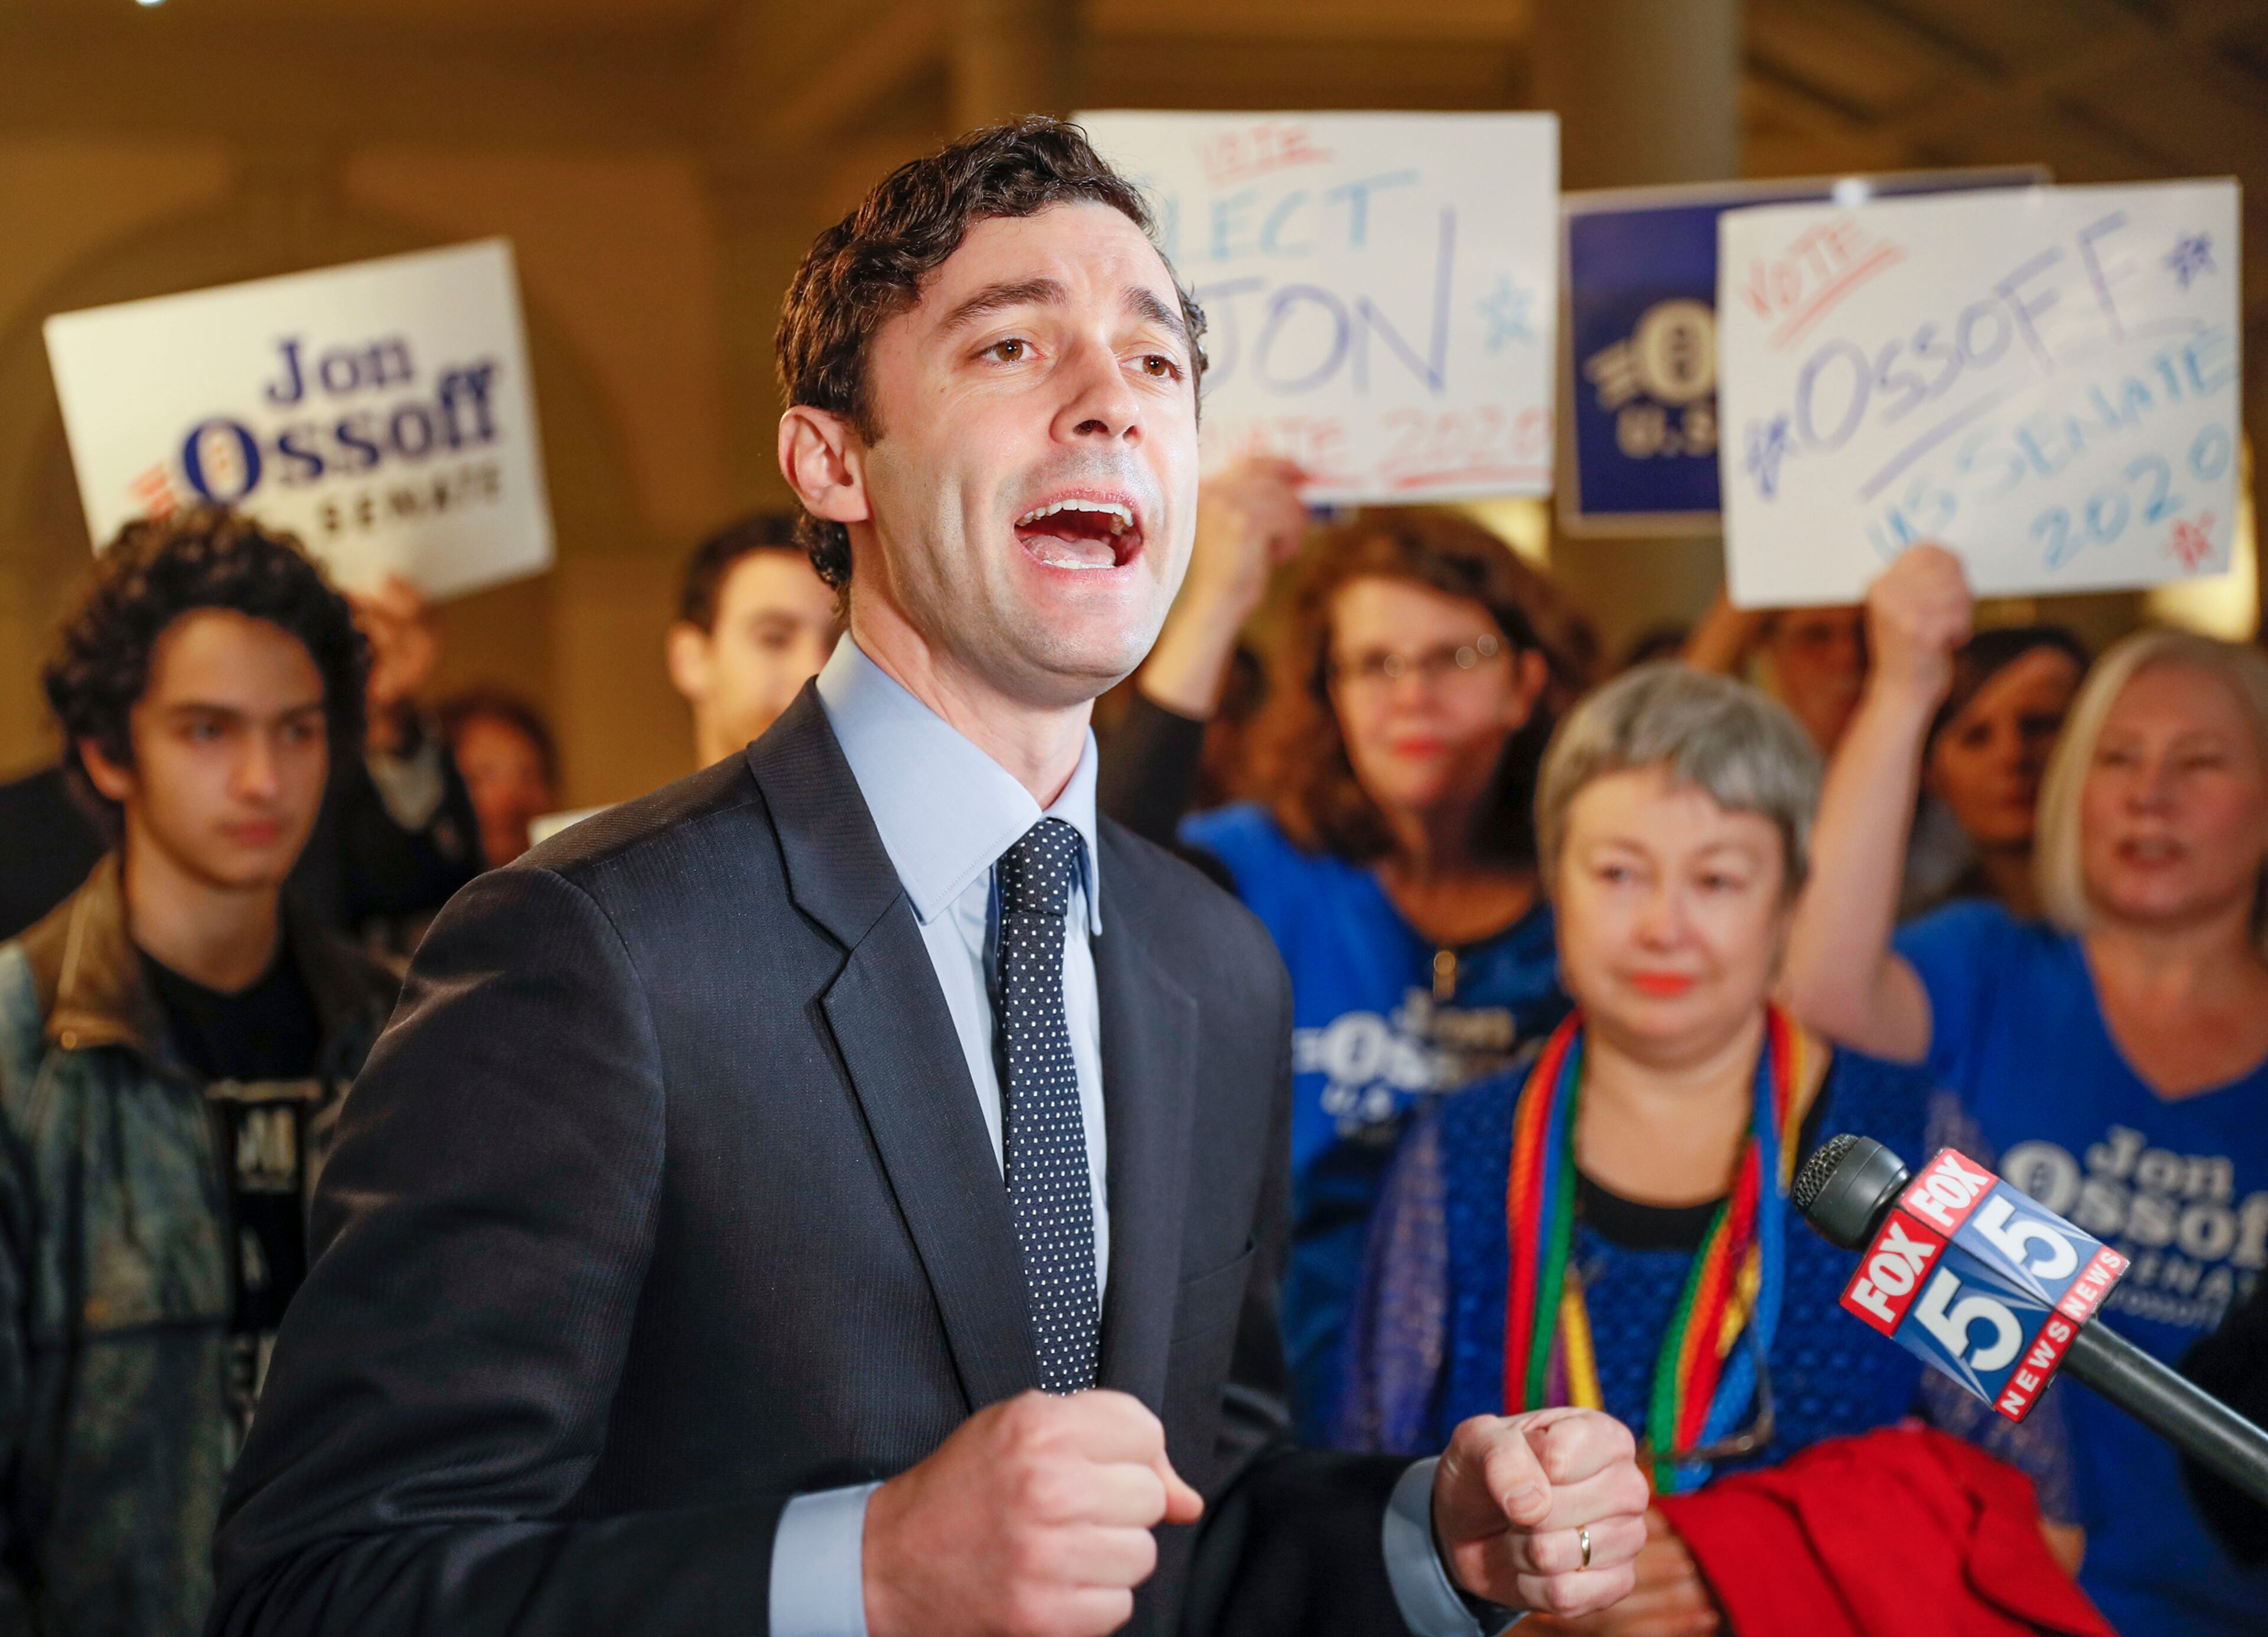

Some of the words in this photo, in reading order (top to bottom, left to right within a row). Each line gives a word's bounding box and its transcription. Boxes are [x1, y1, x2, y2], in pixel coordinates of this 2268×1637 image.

[1192, 121, 1309, 171] VOTE
[1143, 168, 1420, 264] LECT
[1196, 203, 1456, 397] JON
[1740, 216, 1863, 316] VOTE
[265, 334, 413, 405] Jon
[1794, 209, 2139, 454] OSSOFF
[182, 359, 500, 506] Ossoff
[1376, 404, 1550, 475] 2020
[1866, 473, 1959, 567] US
[1954, 325, 2240, 502] SENATE
[320, 458, 501, 536] SENATE
[2028, 422, 2233, 573] 2020
[1908, 1154, 1990, 1228] FOX
[1998, 1138, 2268, 1271] Ossof
[2084, 1124, 2234, 1199] Jon
[1850, 1221, 1937, 1323] FOX
[1972, 1193, 2080, 1281] 5
[2061, 1251, 2121, 1318] NEWS
[1913, 1266, 2023, 1372] 5
[2000, 1319, 2071, 1416] NEWS
